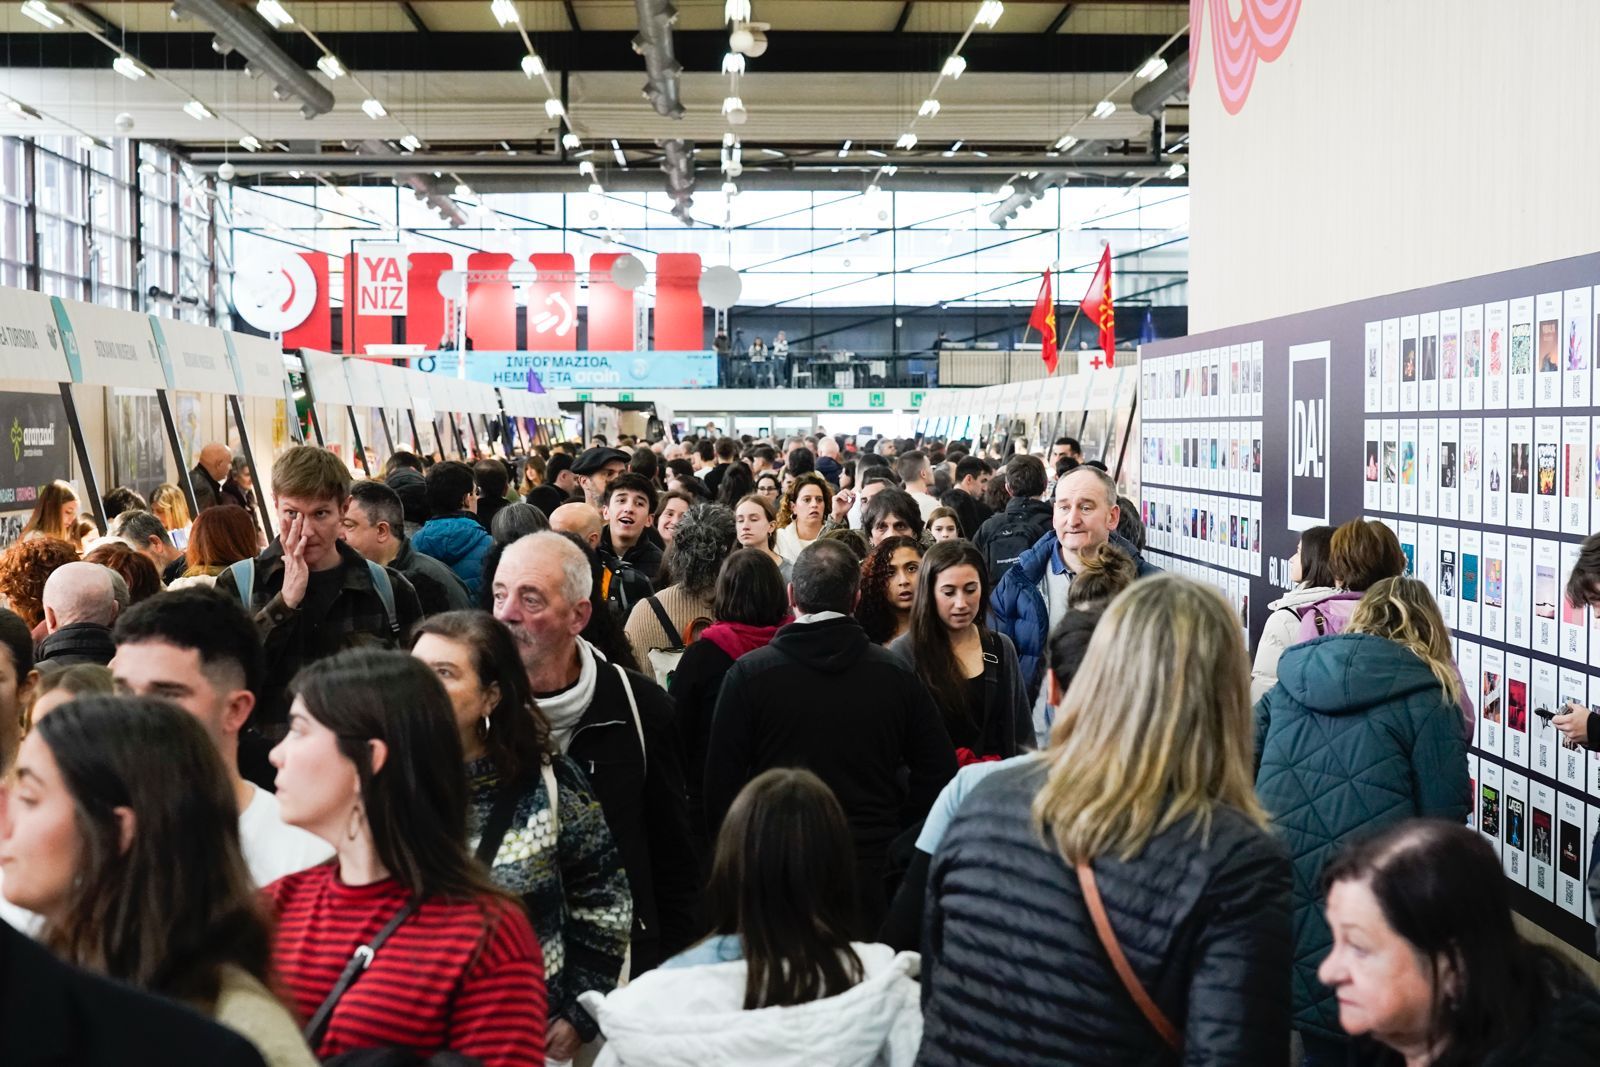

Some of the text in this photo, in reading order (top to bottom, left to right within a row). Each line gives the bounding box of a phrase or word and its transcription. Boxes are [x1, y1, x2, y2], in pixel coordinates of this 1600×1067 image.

[363, 257, 403, 281] YA
[362, 286, 403, 309] NIZ
[494, 368, 620, 384] HEMN ETA orain
[23, 422, 55, 446] aranzadi
[1294, 398, 1323, 478] DA!
[1269, 555, 1279, 587] 60.
